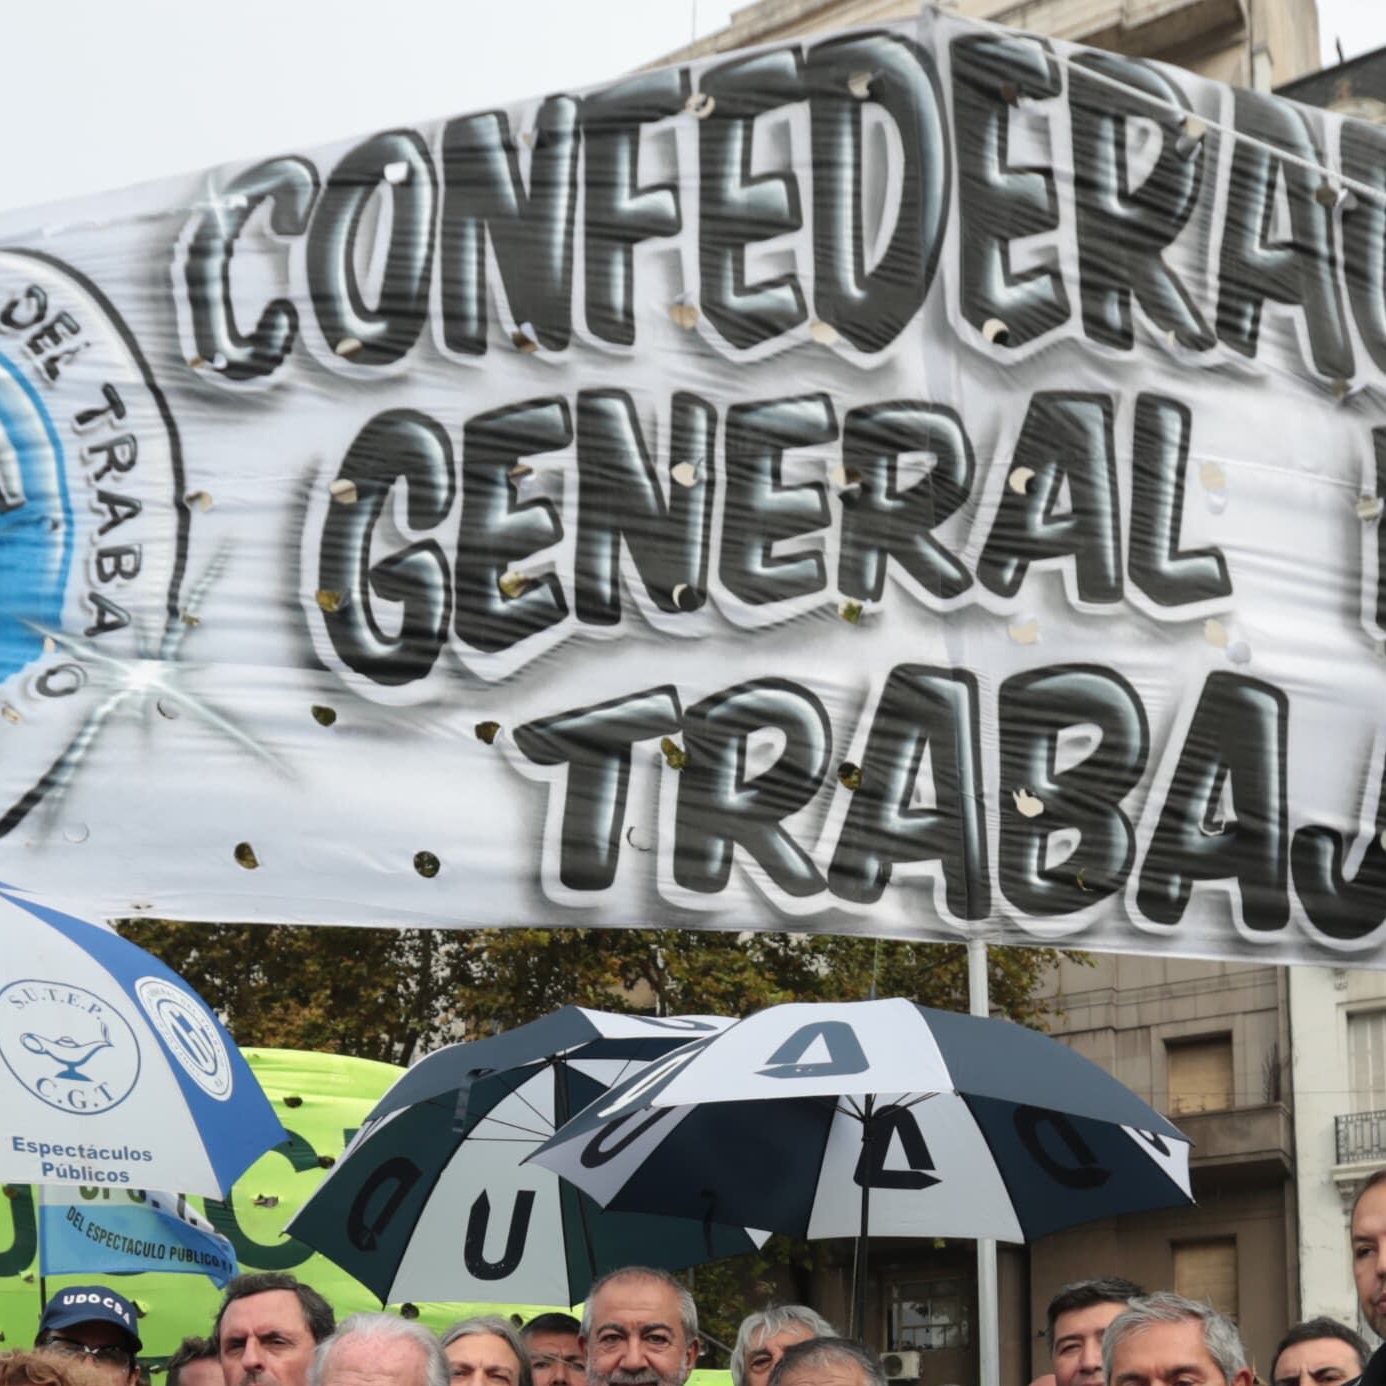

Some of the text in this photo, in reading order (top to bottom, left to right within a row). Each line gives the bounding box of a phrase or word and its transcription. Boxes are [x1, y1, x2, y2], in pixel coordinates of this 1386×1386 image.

[0, 284, 83, 382] DEL
[33, 381, 142, 700] TRABAO
[315, 391, 1232, 686] GENERAL
[8, 986, 102, 1021] S.U.T.E.P.
[35, 1077, 115, 1110] C.G.T
[11, 1135, 154, 1162] Espectáculos
[41, 1161, 131, 1184] Públicos
[66, 1205, 83, 1233] DEL
[86, 1224, 166, 1260] ESPECTACULO
[169, 1246, 220, 1267] PUBLICO
